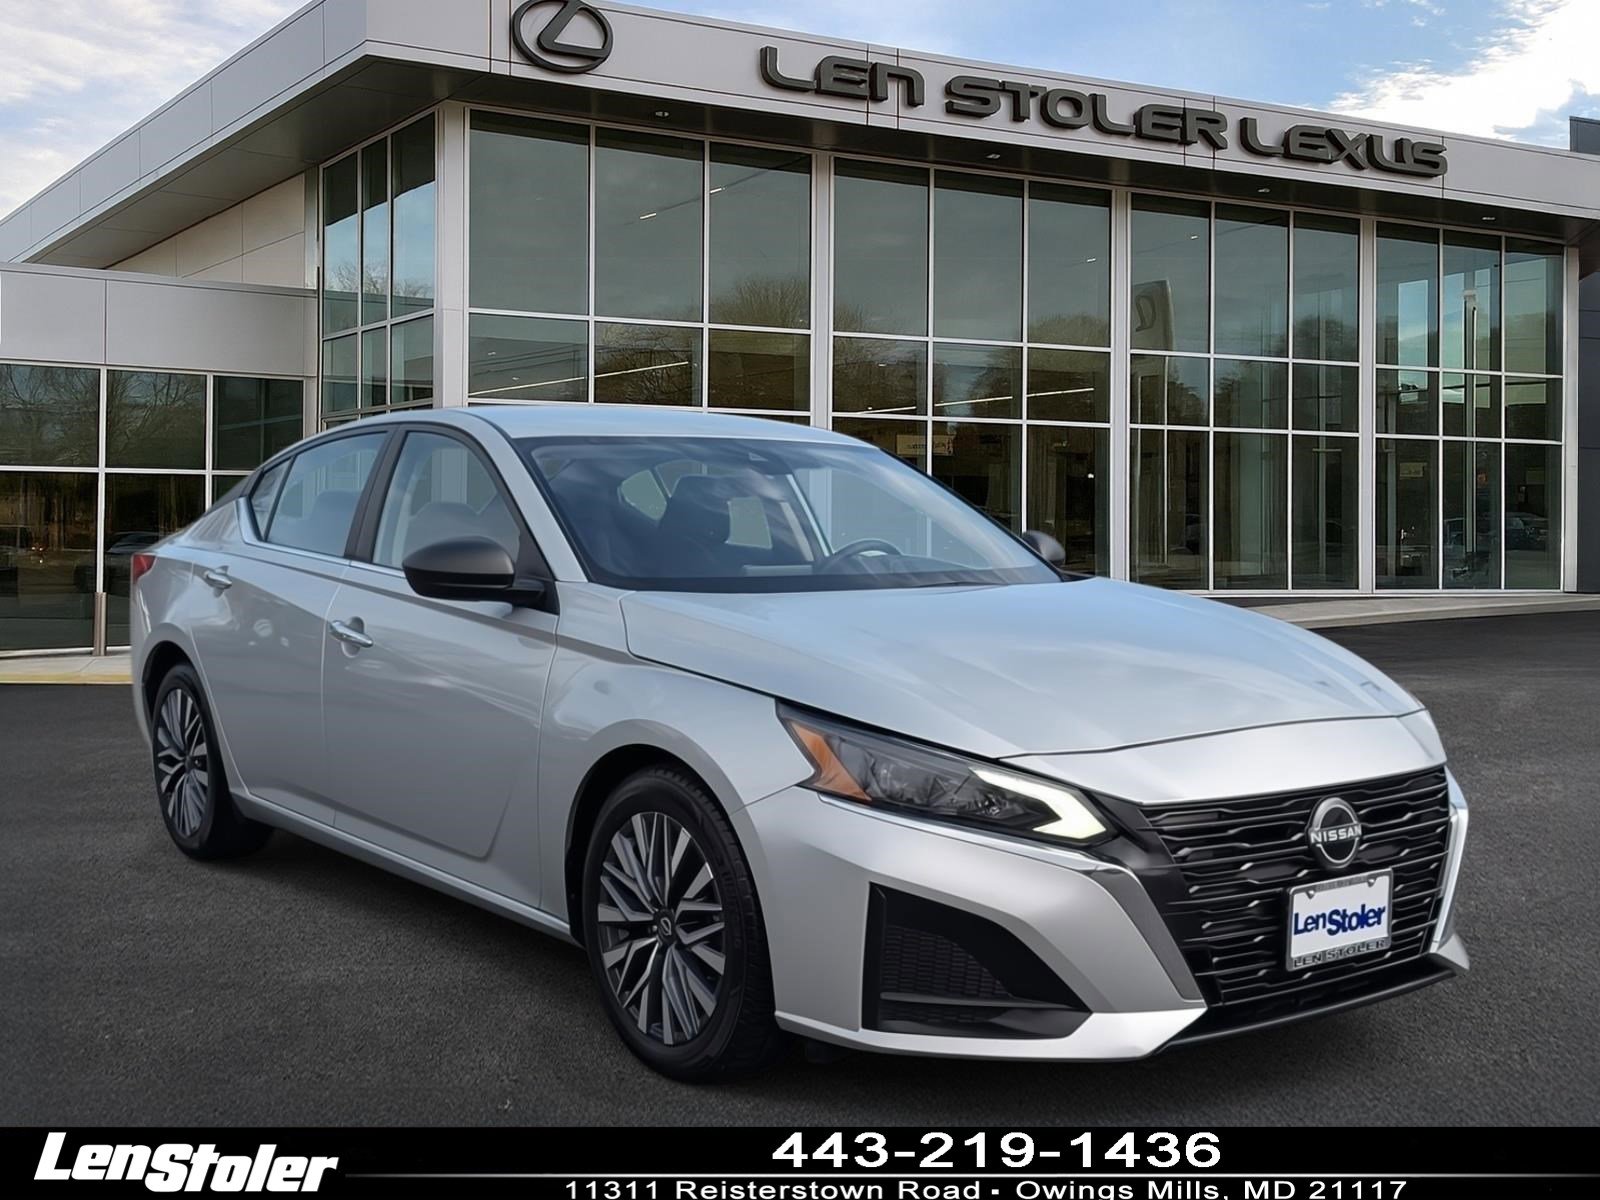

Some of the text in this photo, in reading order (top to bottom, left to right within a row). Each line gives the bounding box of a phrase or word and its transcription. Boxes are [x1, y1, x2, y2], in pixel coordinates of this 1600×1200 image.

[946, 75, 1228, 150] STOLER
[1240, 117, 1448, 177] LEXUS
[1310, 823, 1362, 844] NISSAN
[1293, 904, 1386, 936] LenStoler
[1294, 939, 1386, 968] LEN STOLER
